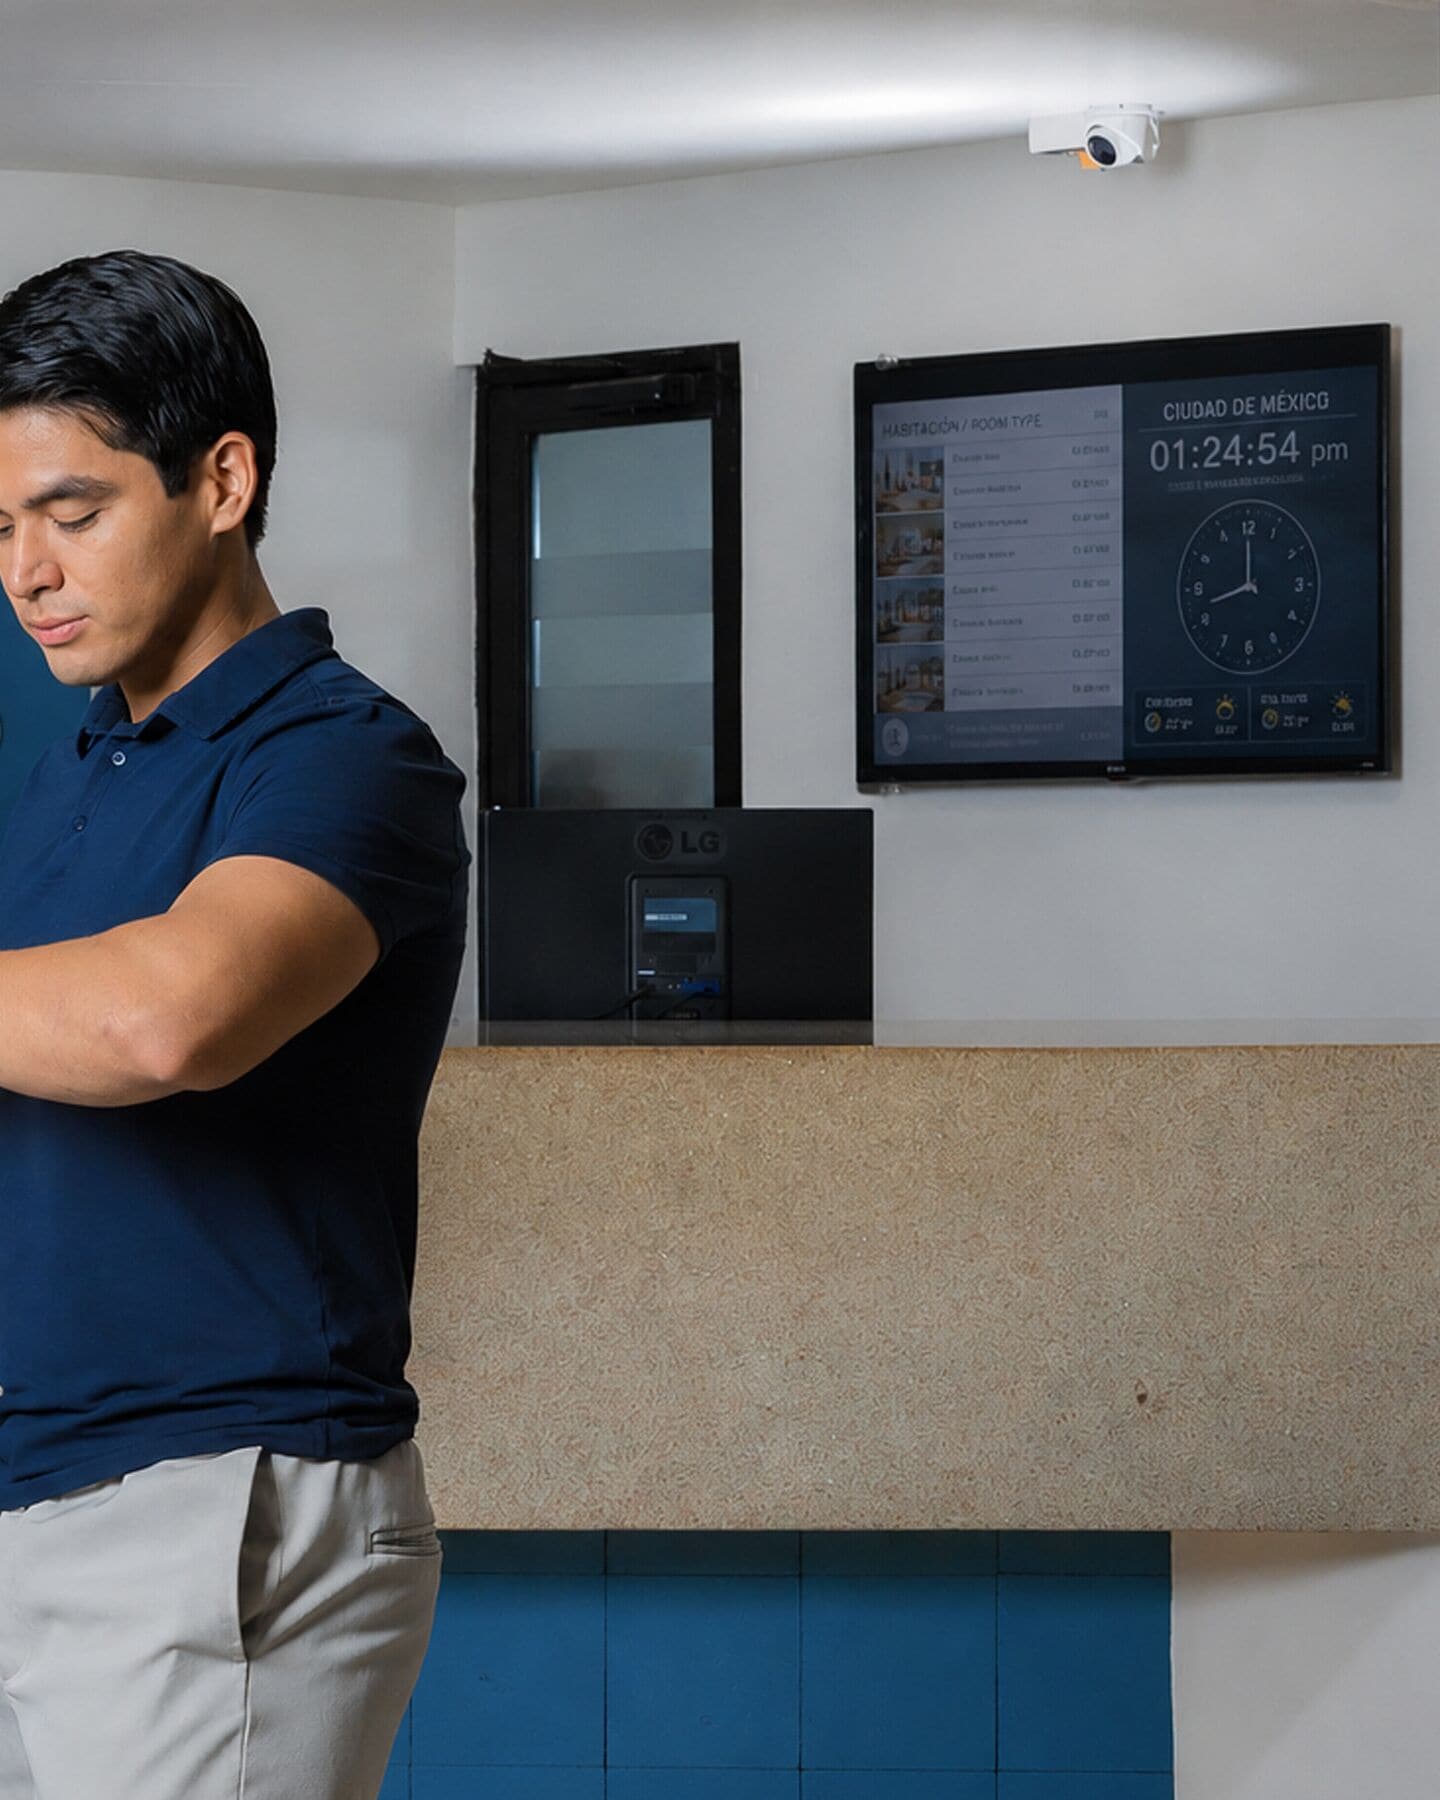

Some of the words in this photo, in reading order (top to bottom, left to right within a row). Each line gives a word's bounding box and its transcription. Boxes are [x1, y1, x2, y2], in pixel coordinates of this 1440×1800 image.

[1163, 399, 1228, 421] CIUDAD
[1232, 396, 1256, 415] DE
[1149, 430, 1301, 472] 01:24:54
[1311, 441, 1348, 468] pm
[1241, 520, 1256, 536] 12
[1193, 581, 1203, 596] 9
[1294, 577, 1304, 593] 3
[1220, 634, 1229, 648] 7
[1244, 640, 1254, 655] 6
[681, 831, 721, 853] LG
